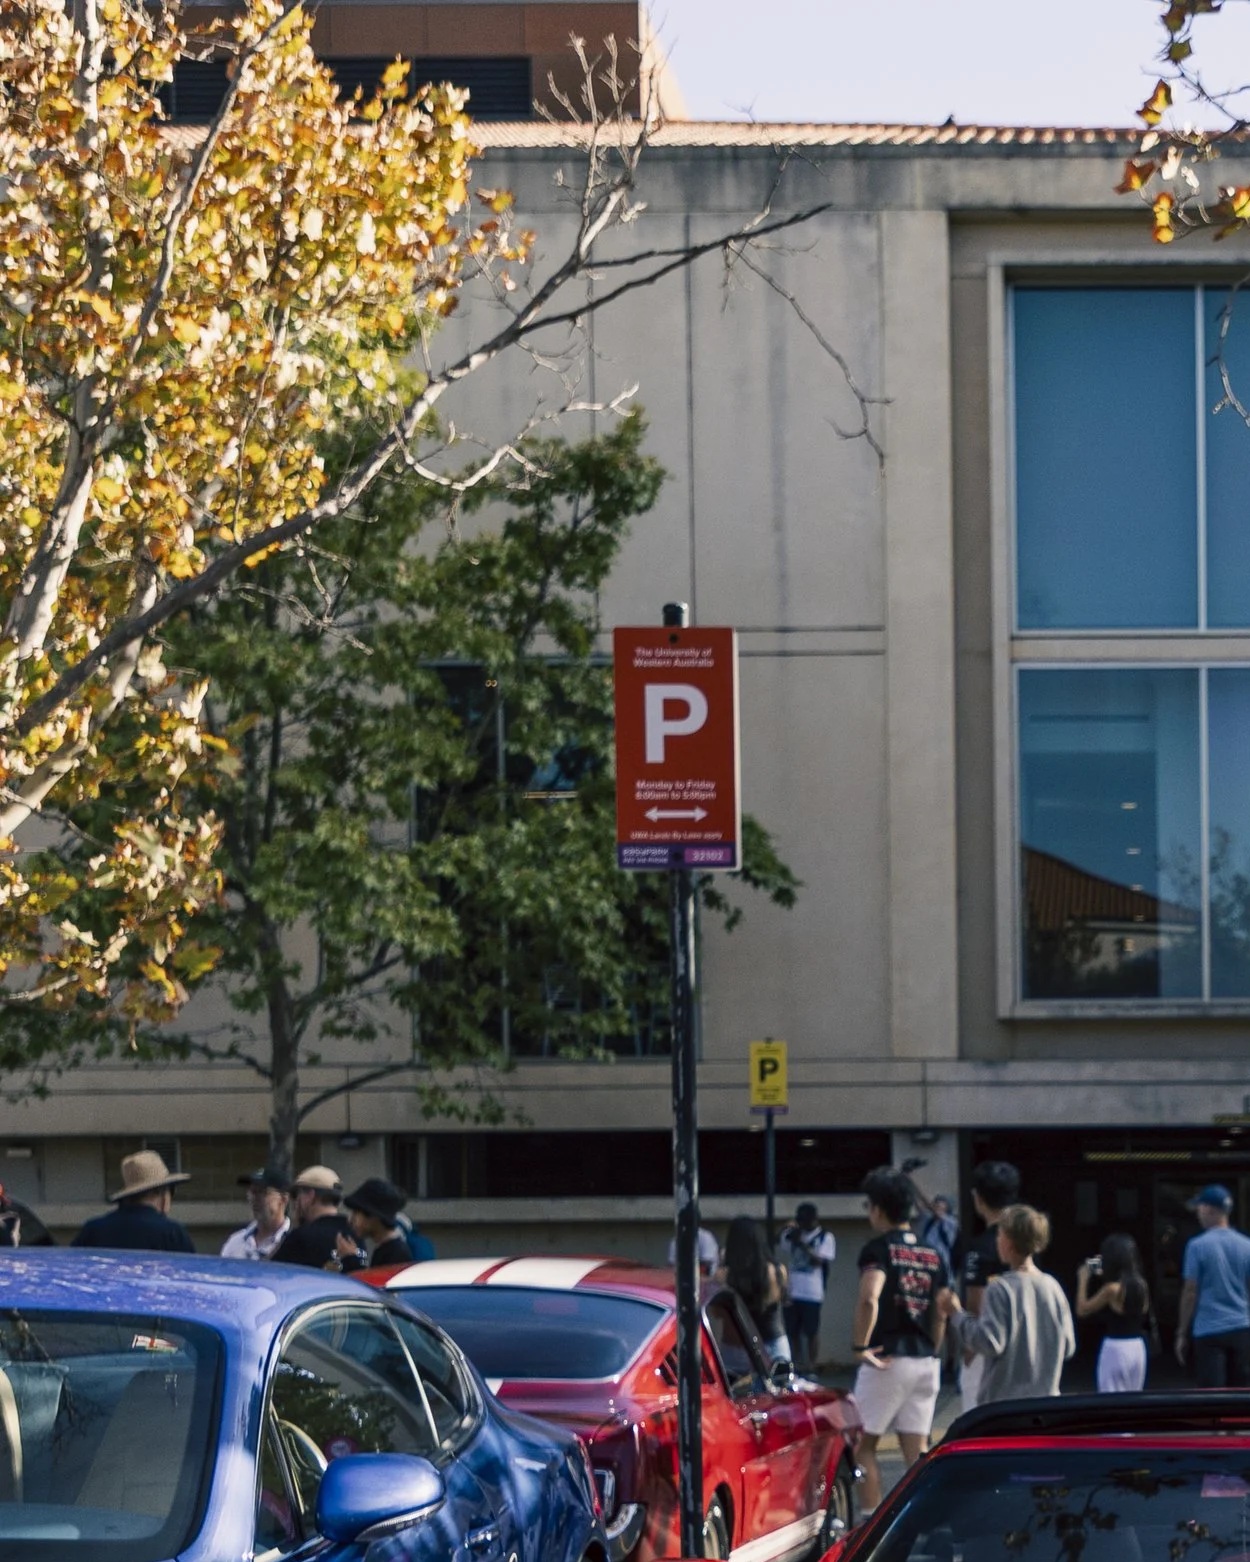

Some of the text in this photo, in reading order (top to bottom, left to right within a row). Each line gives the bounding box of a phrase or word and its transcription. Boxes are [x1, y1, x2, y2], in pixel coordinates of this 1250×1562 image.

[634, 646, 712, 659] The University of
[633, 657, 715, 668] Western Australia
[644, 683, 708, 764] P
[636, 779, 716, 791] Monday to Friday
[759, 1058, 779, 1083] P
